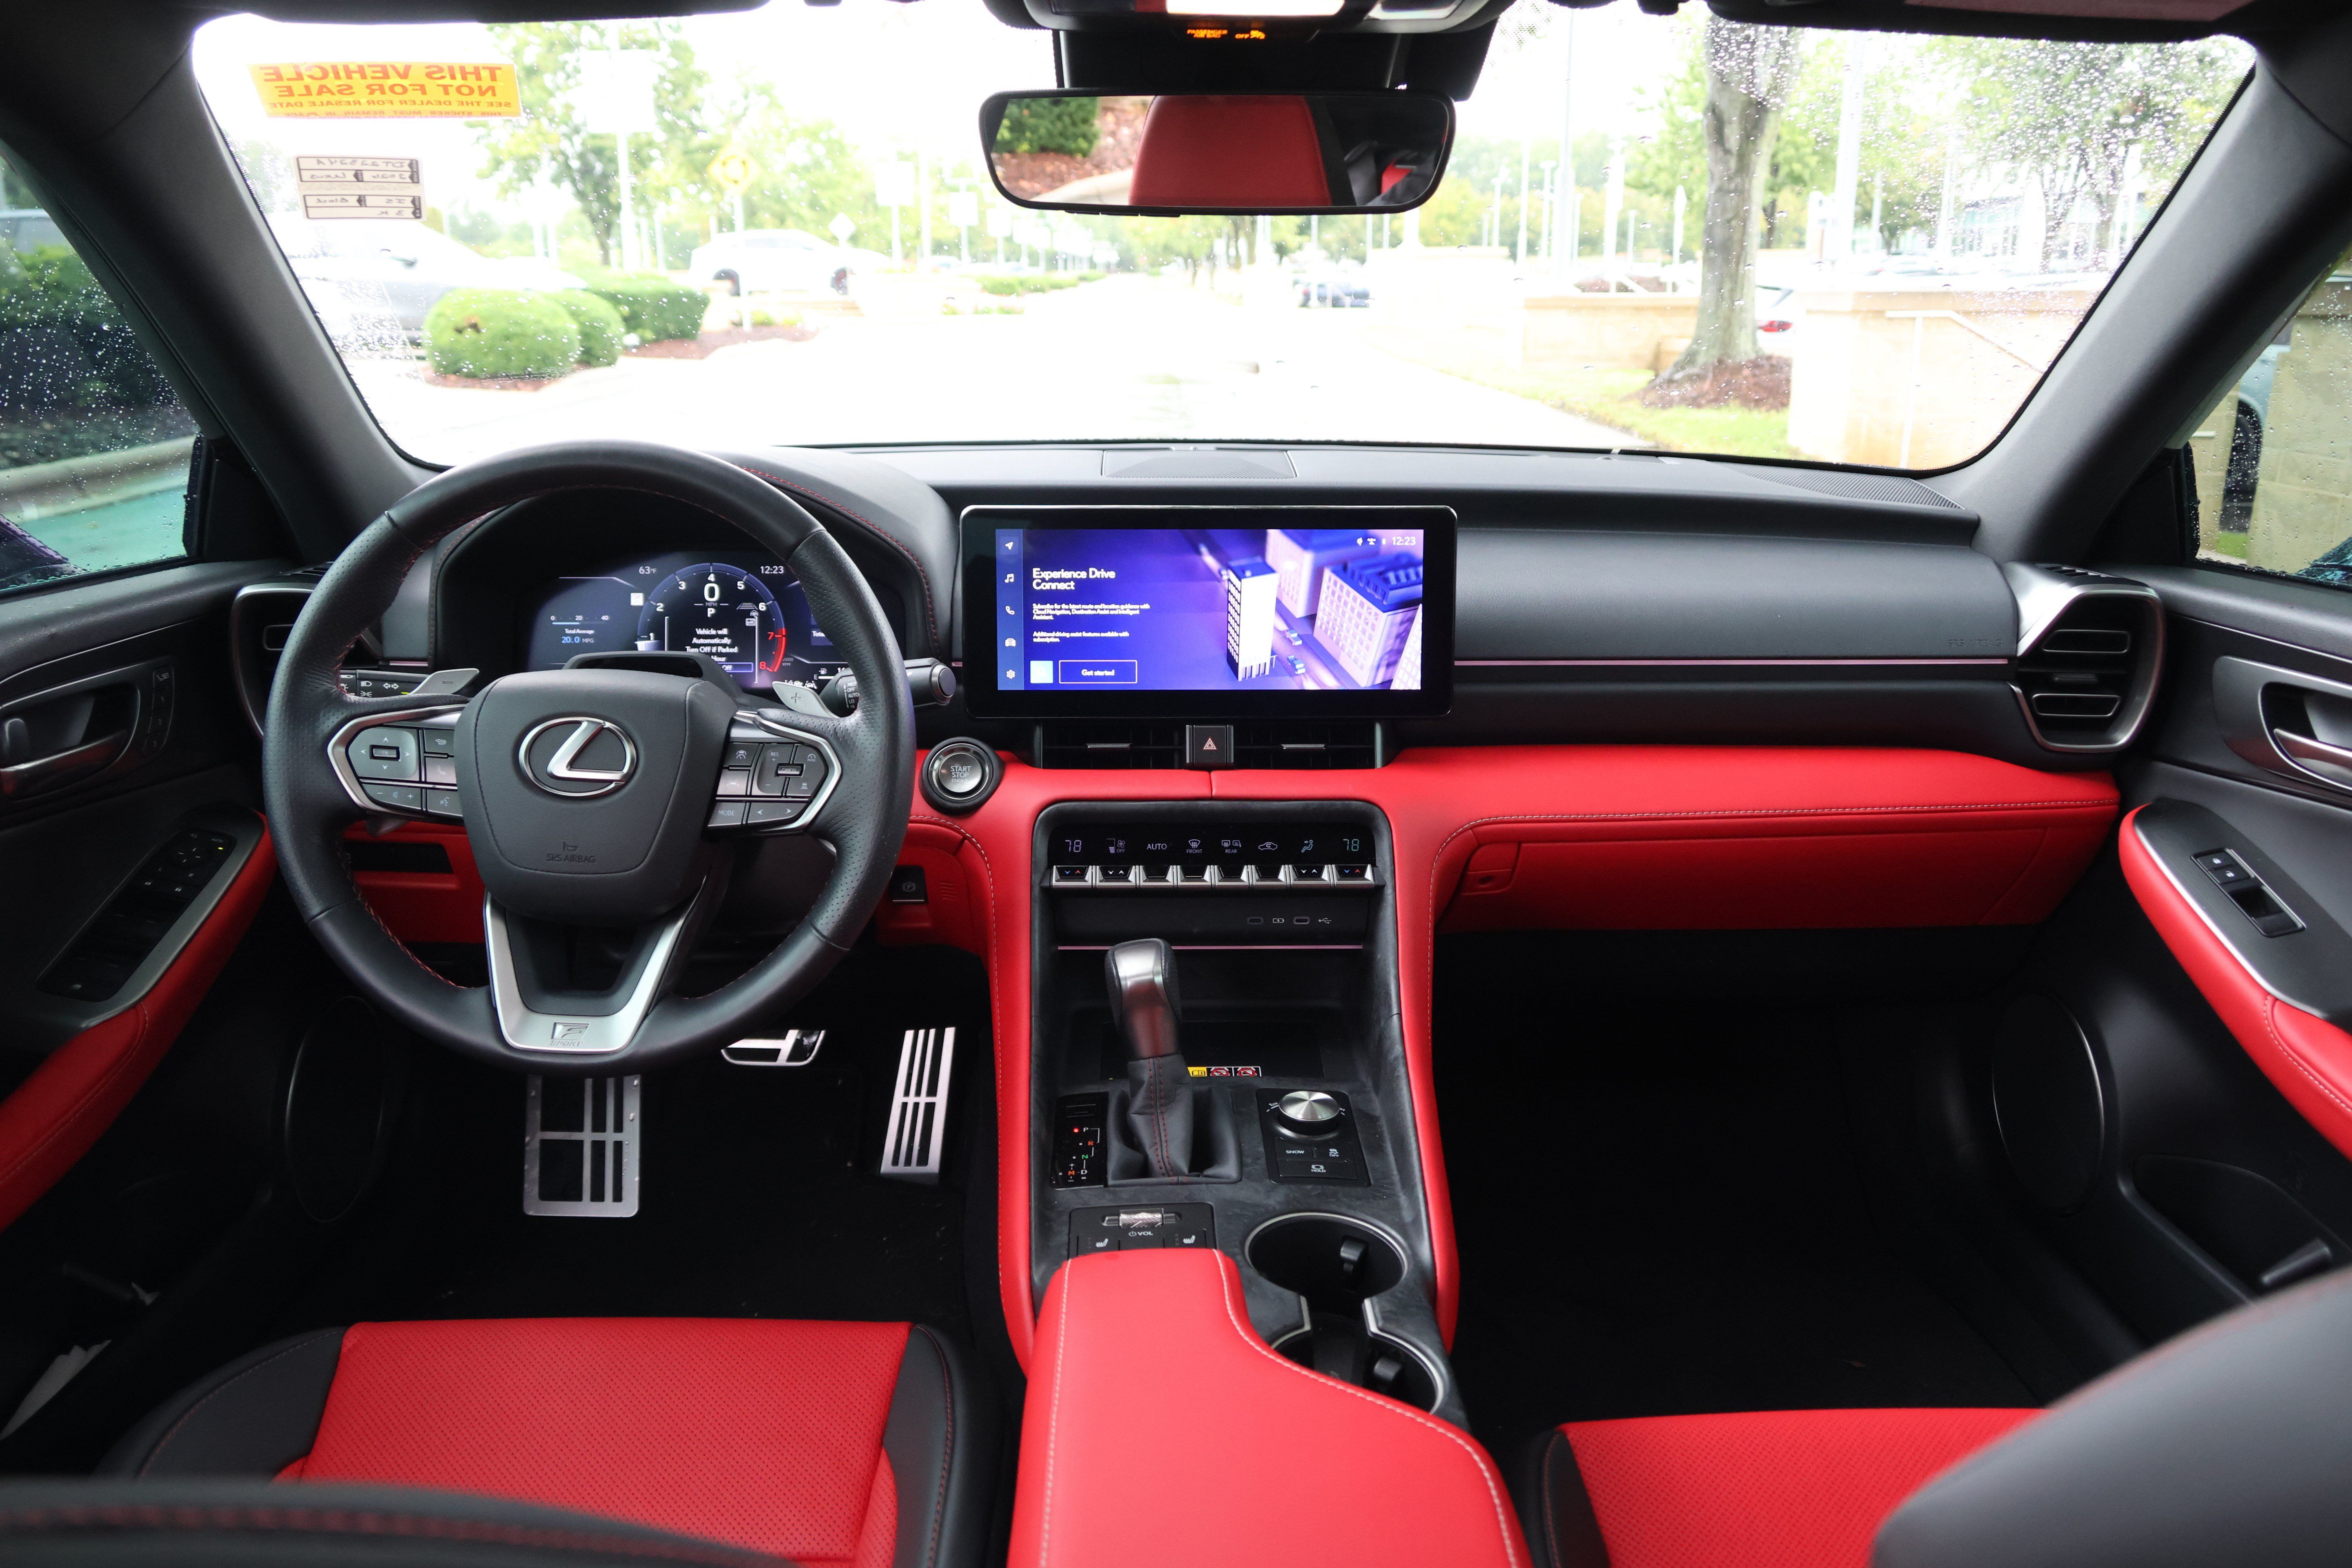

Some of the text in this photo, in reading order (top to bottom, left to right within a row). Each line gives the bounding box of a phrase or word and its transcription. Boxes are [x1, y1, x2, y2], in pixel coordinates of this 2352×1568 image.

[1392, 536, 1416, 546] 12:23
[760, 566, 784, 574] 12:23
[1033, 568, 1116, 580] Experience Drive
[707, 573, 715, 582] 4
[678, 581, 686, 590] 3
[737, 581, 745, 590] 5
[1033, 579, 1075, 590] Connect
[703, 583, 720, 601] 0
[656, 603, 664, 612] 2
[758, 602, 766, 611] 6
[707, 608, 715, 617] P
[649, 633, 655, 641] 1
[760, 661, 766, 669] 8
[1065, 840, 1082, 853] 78
[1343, 839, 1360, 851] 78
[564, 855, 597, 863] AIRBAG
